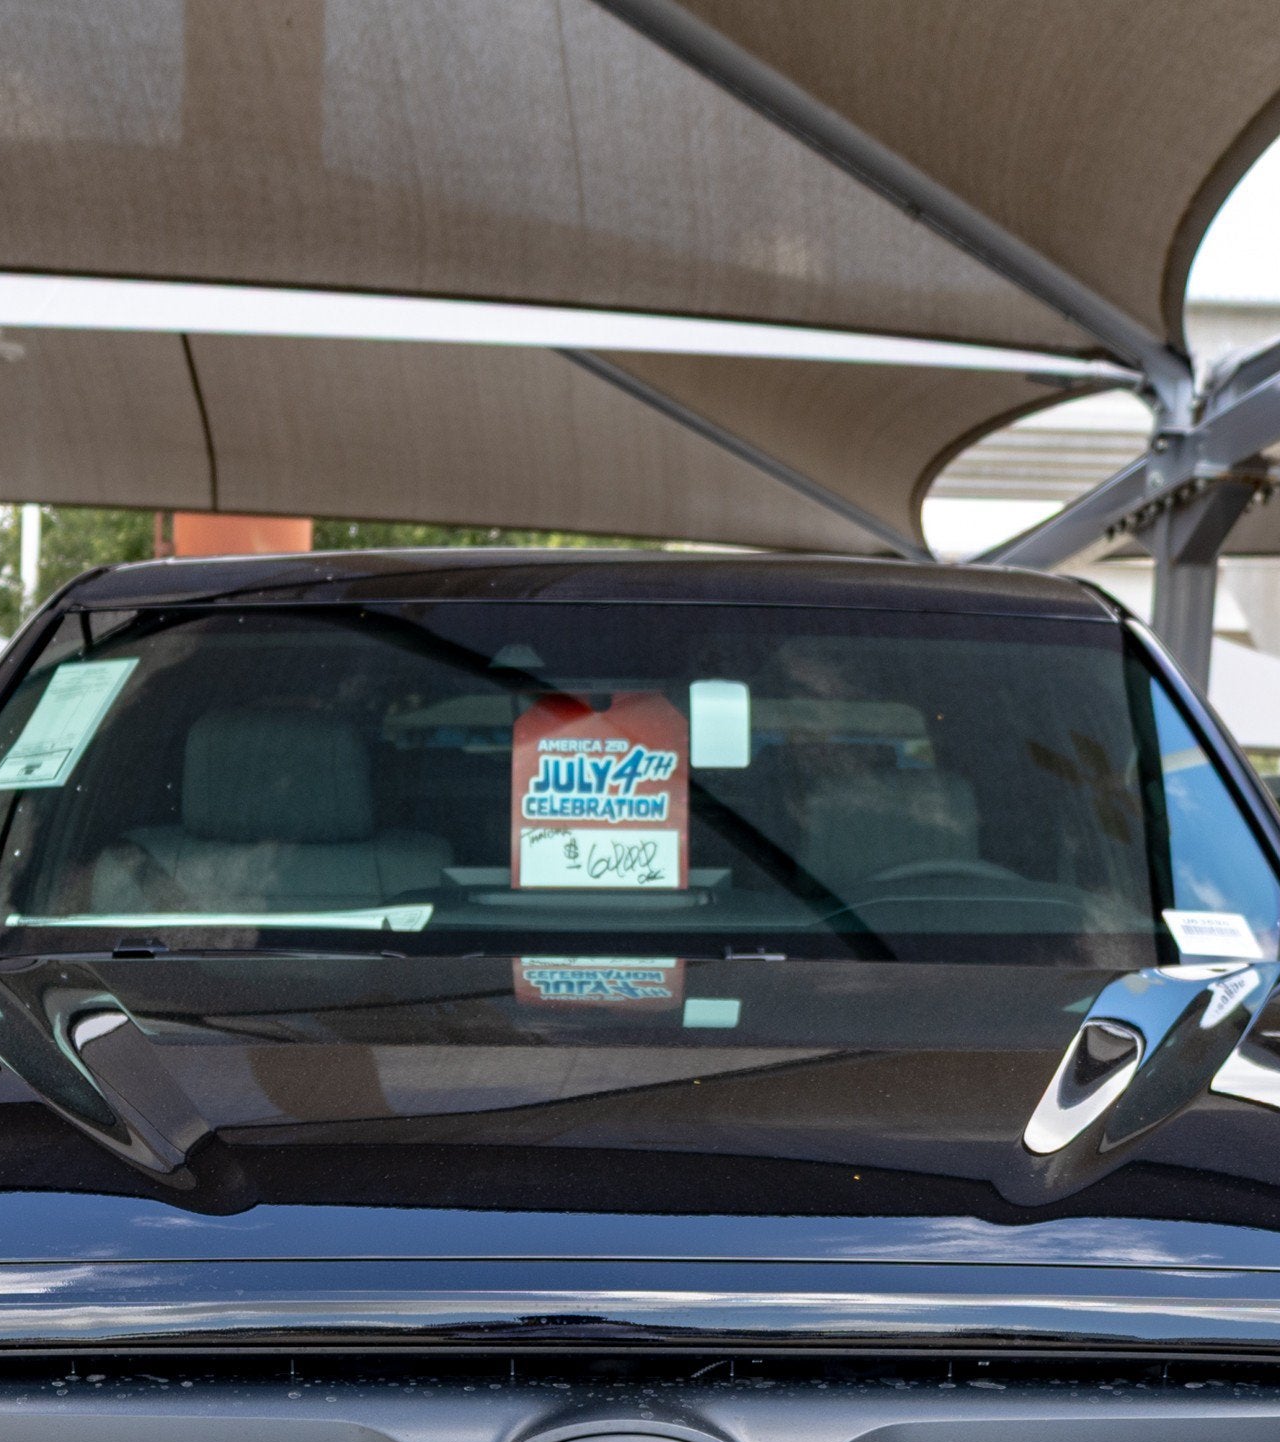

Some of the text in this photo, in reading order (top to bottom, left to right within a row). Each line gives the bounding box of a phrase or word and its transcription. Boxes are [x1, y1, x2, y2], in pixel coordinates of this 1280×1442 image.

[537, 739, 629, 752] AMERICA 250
[532, 749, 675, 795] JULY 4TH
[524, 795, 666, 820] CELEBRATION
